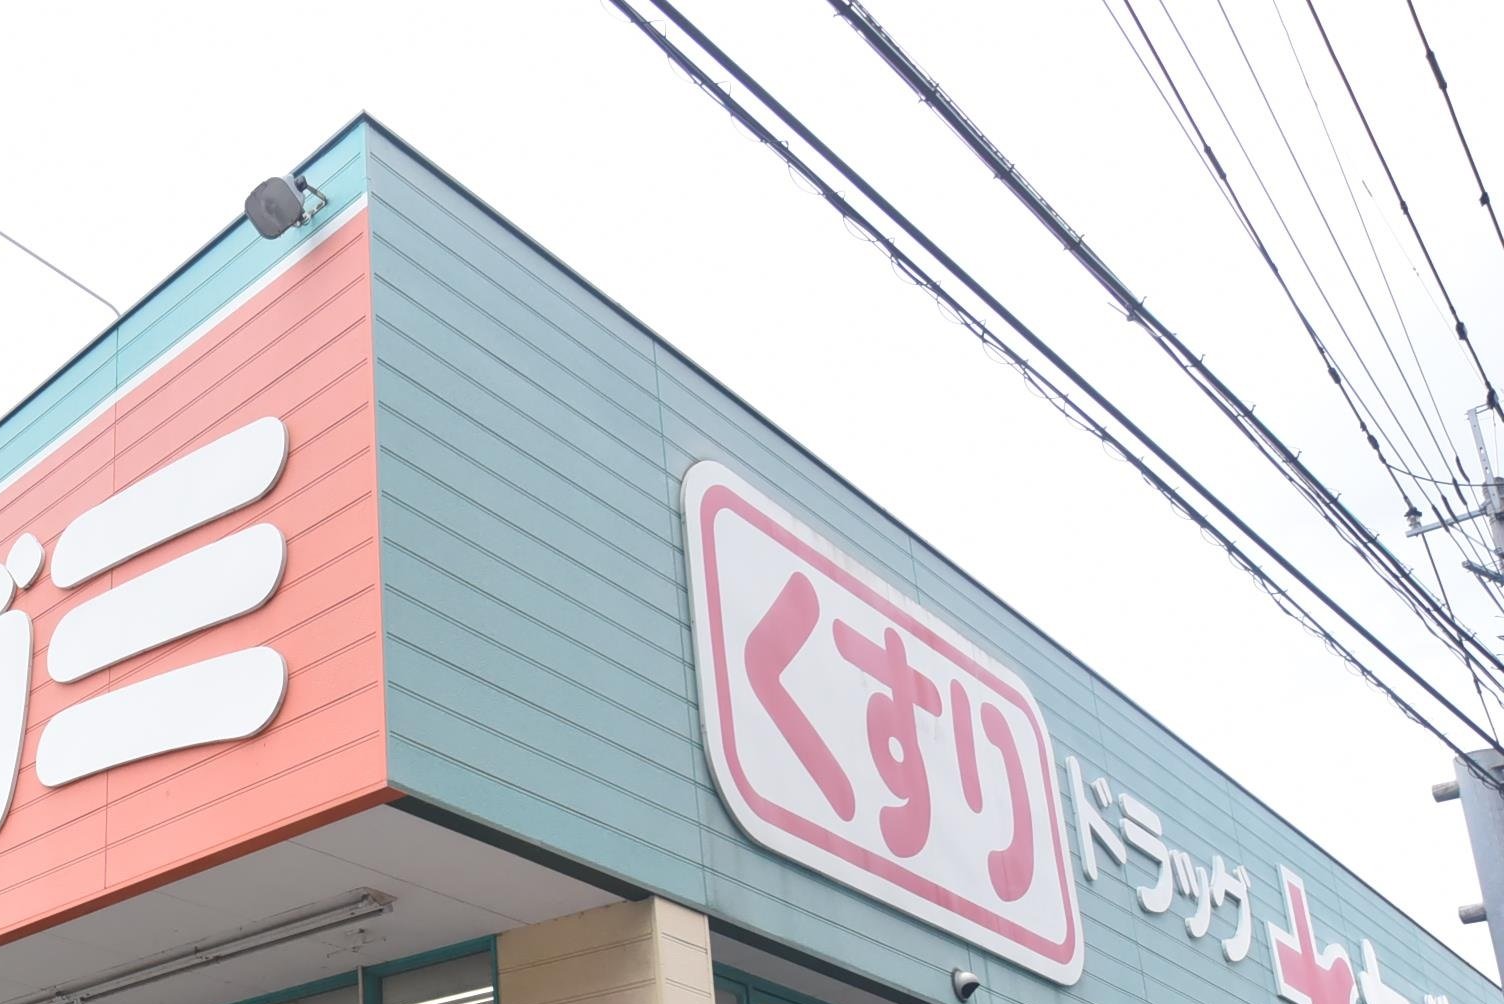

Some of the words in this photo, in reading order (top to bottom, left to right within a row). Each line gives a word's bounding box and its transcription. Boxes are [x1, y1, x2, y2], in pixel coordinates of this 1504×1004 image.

[744, 570, 1034, 903] くすり
[1066, 755, 1252, 963] ドラッグ
